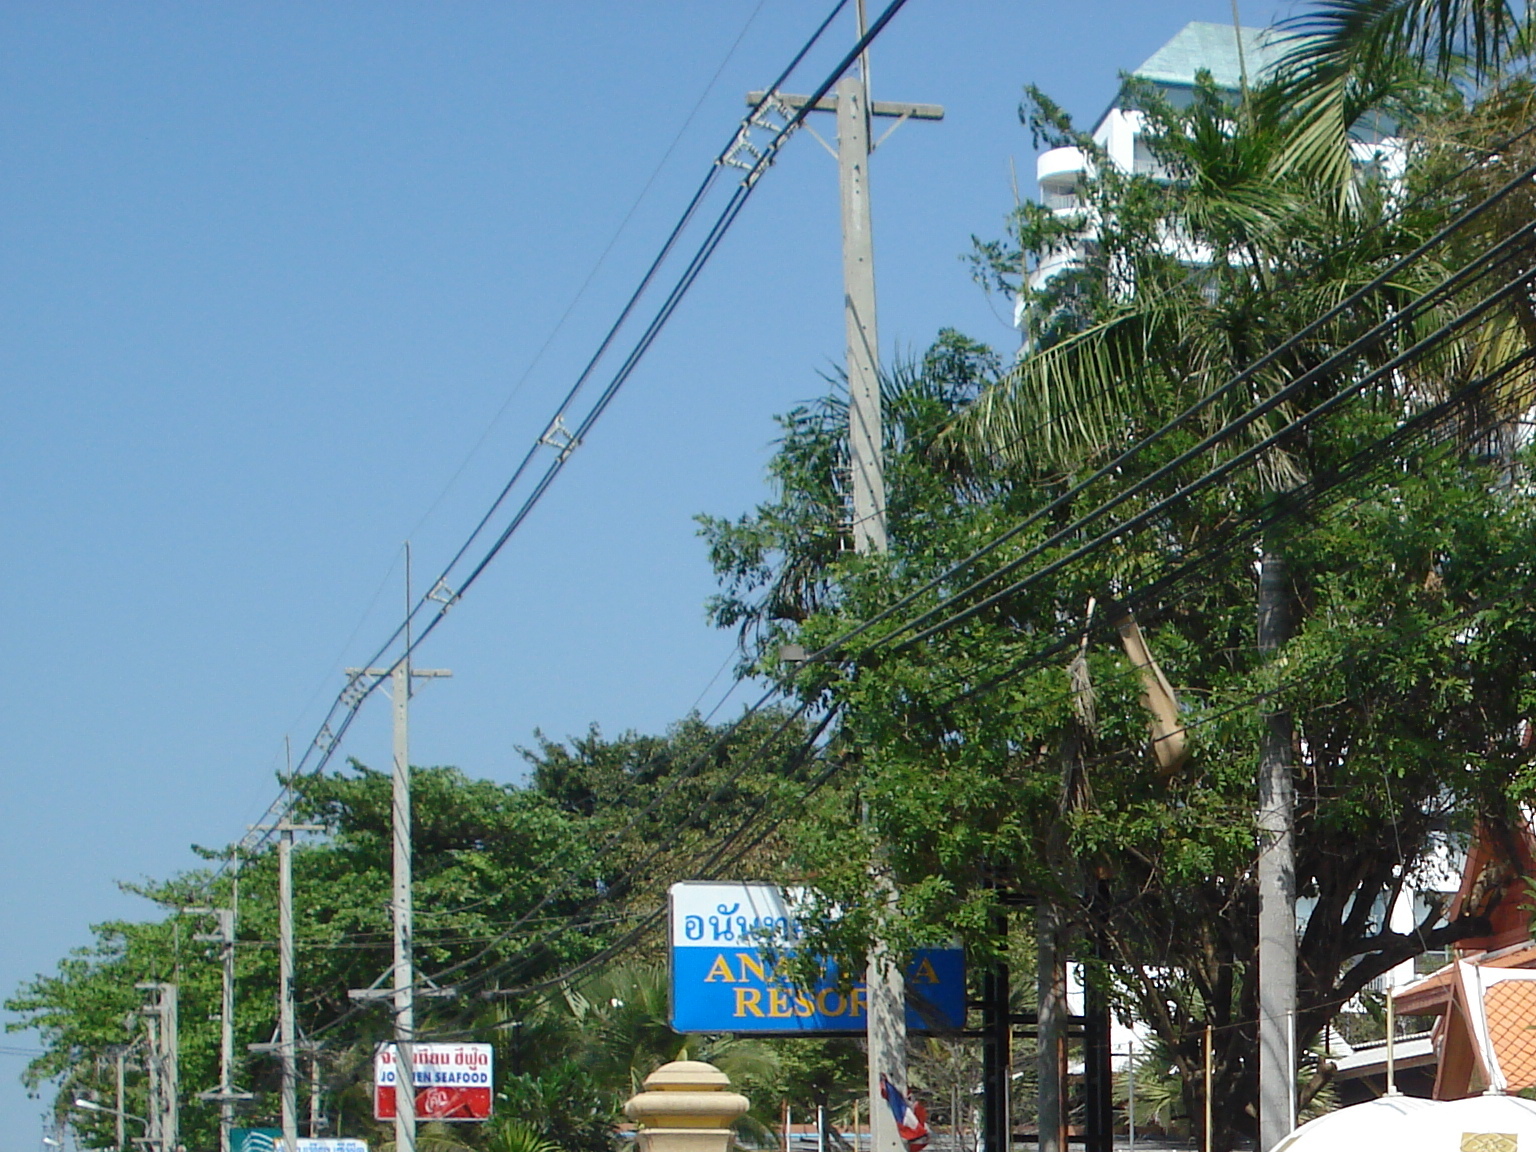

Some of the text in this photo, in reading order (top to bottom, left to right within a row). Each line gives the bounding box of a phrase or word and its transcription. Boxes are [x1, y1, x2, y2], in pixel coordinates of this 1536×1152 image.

[733, 987, 868, 1018] RESOR
[381, 1071, 488, 1083] JOIEN SEAFOOD
